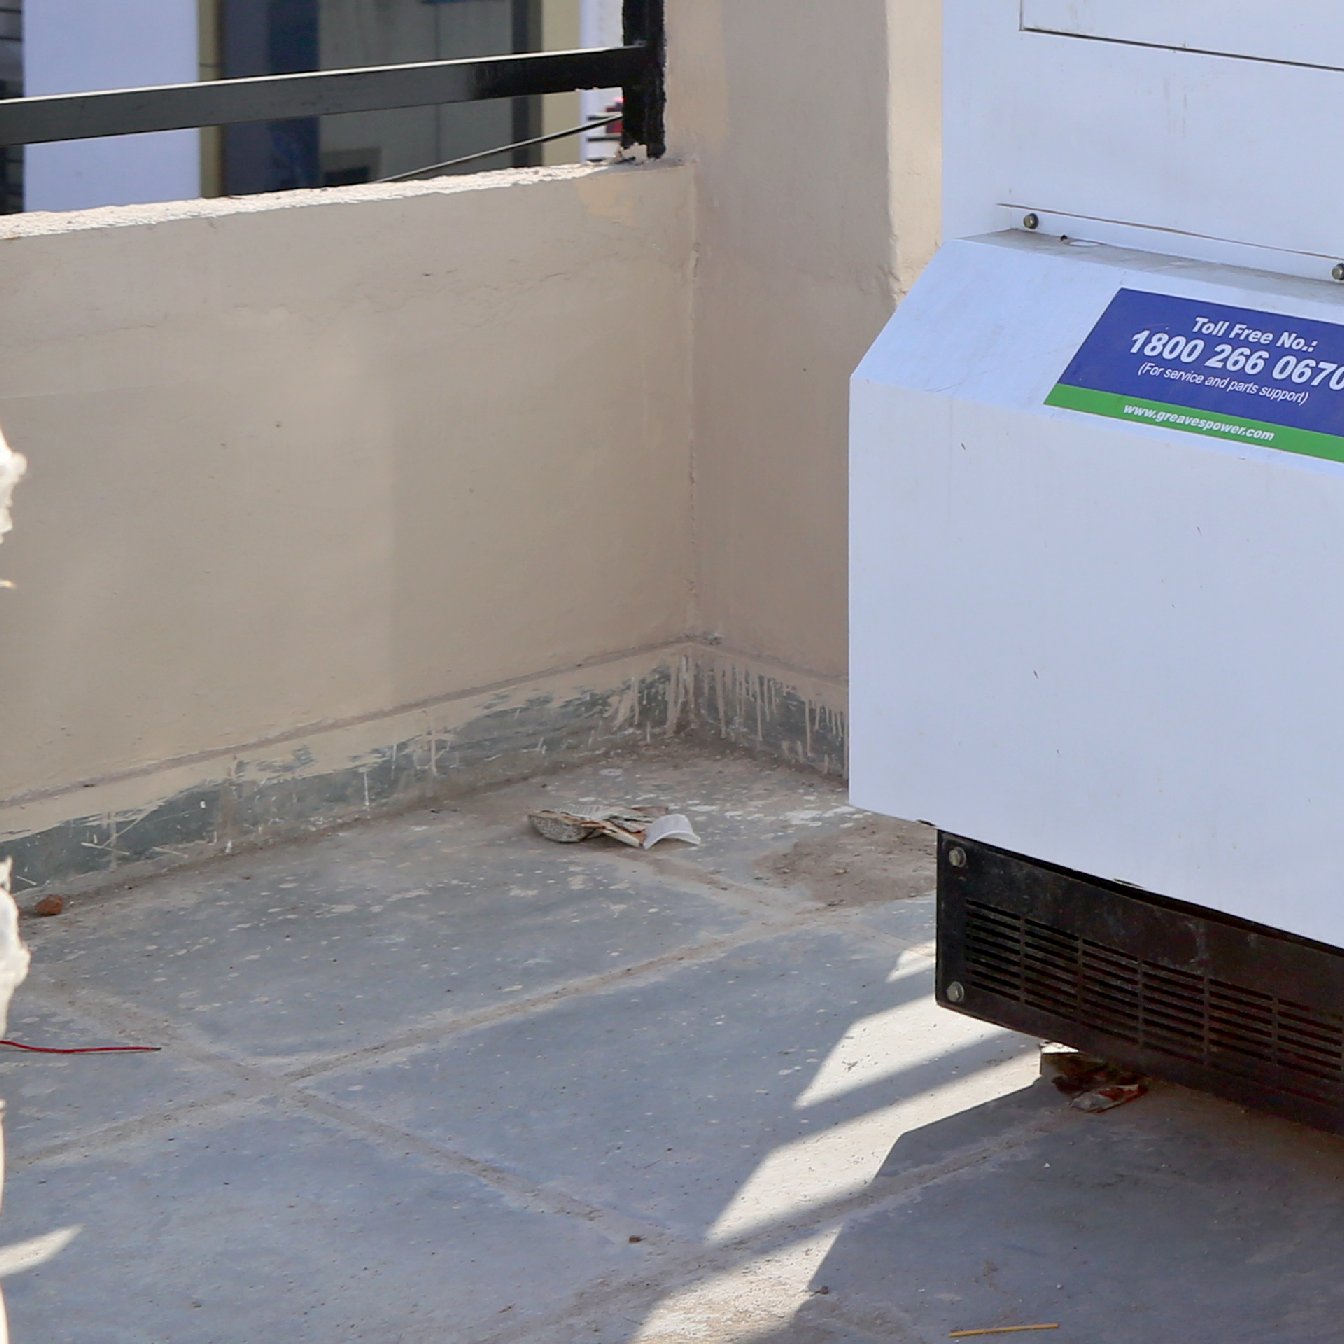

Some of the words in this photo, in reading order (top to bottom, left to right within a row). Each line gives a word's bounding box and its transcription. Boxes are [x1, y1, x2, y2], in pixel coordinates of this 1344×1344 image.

[1129, 330, 1205, 363] 1800
[1205, 344, 1269, 375] 266
[1192, 316, 1229, 337] Toll
[1229, 324, 1274, 345] Free
[1275, 331, 1319, 353] No.:
[1138, 362, 1163, 377] (For
[1163, 368, 1204, 384] service
[1205, 375, 1229, 389] and
[1227, 380, 1258, 395] parts
[1259, 387, 1309, 406] support)
[1123, 404, 1275, 441] www.greavespower.com
